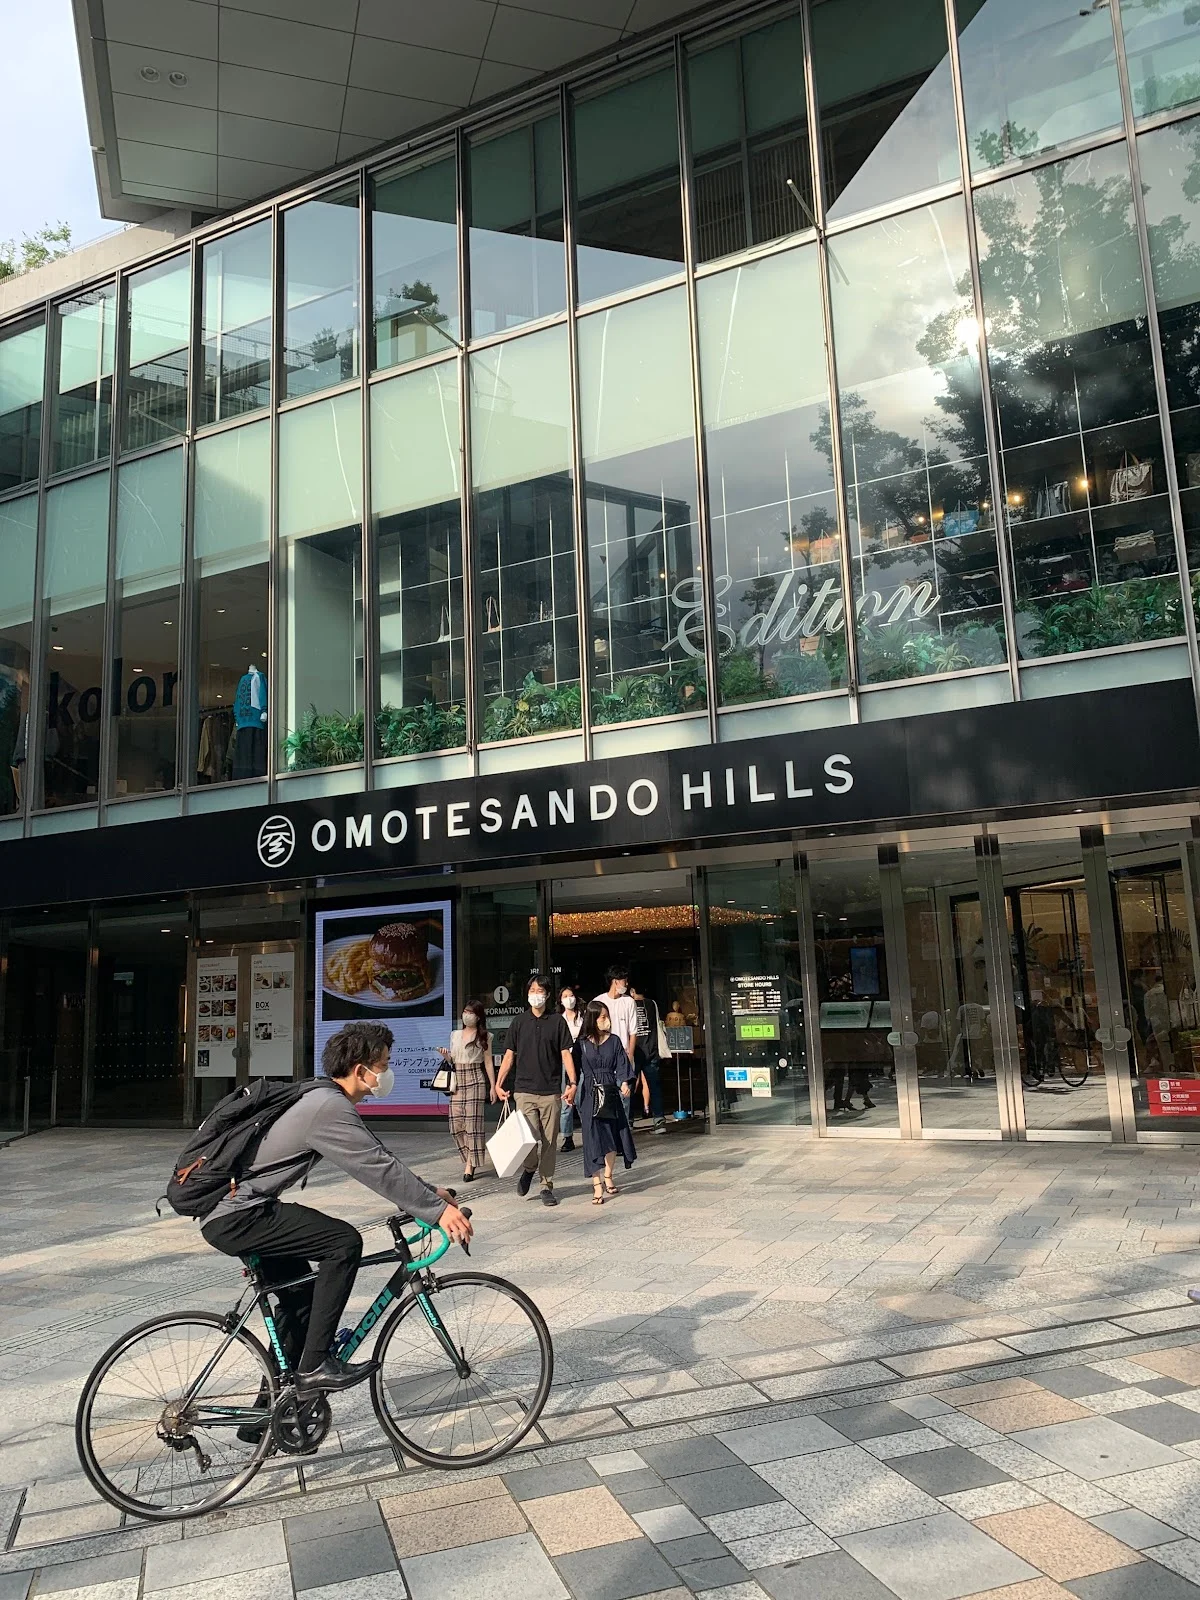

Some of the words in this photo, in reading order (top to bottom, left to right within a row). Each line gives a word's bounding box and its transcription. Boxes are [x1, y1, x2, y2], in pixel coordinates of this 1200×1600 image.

[661, 572, 940, 658] Edition
[48, 657, 182, 730] kolor
[311, 778, 658, 853] OMOTESANDO
[682, 754, 854, 811] HILLS
[255, 1001, 270, 1009] BOX
[484, 1006, 525, 1016] FORMATION
[388, 1057, 442, 1067] ールデンブラウン
[339, 1287, 394, 1363] anchi
[418, 1292, 440, 1327] Bianchi
[264, 1316, 289, 1370] Bianchi
